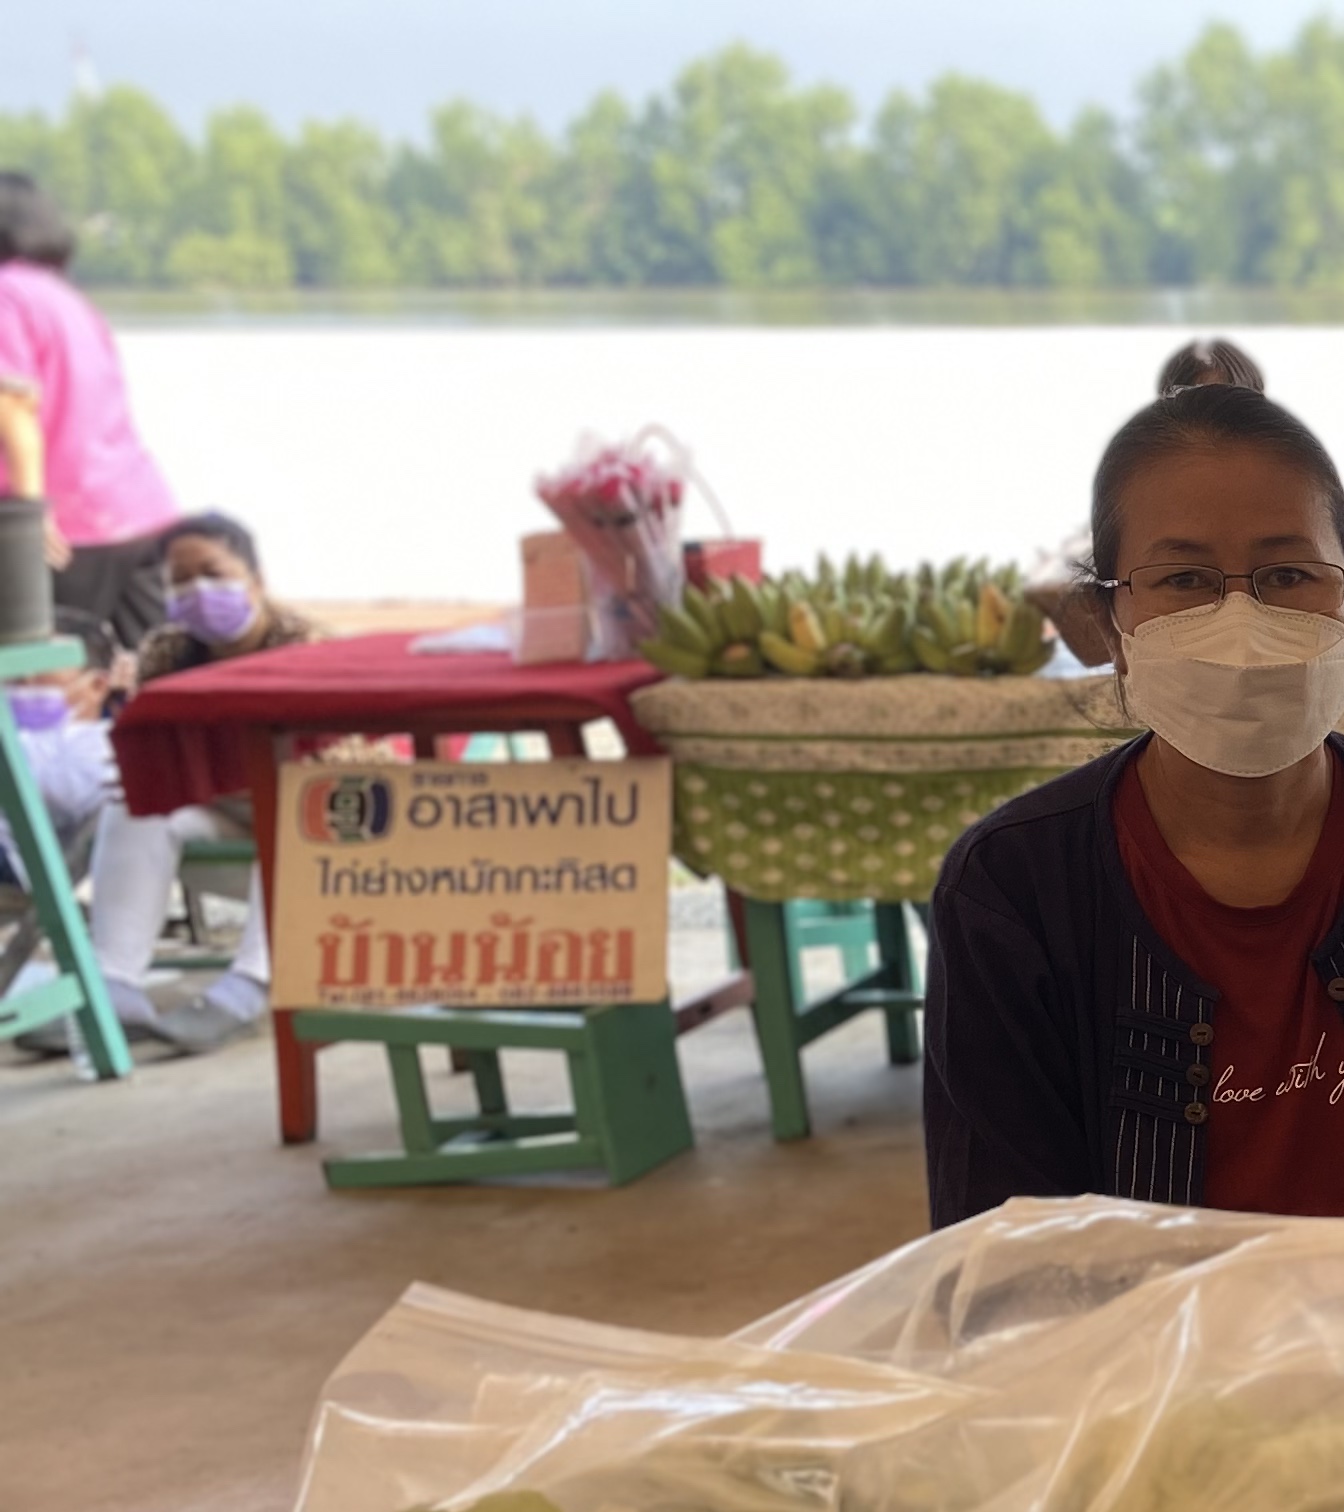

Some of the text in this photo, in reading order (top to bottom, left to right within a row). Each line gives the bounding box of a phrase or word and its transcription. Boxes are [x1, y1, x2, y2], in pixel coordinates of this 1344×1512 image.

[406, 775, 639, 830] อาสาพาไป
[315, 856, 638, 897] ไก่ย่างหมักกะทิสด
[316, 911, 635, 987] บ้านน้อย
[1213, 1064, 1267, 1103] love
[1275, 1031, 1326, 1096] with
